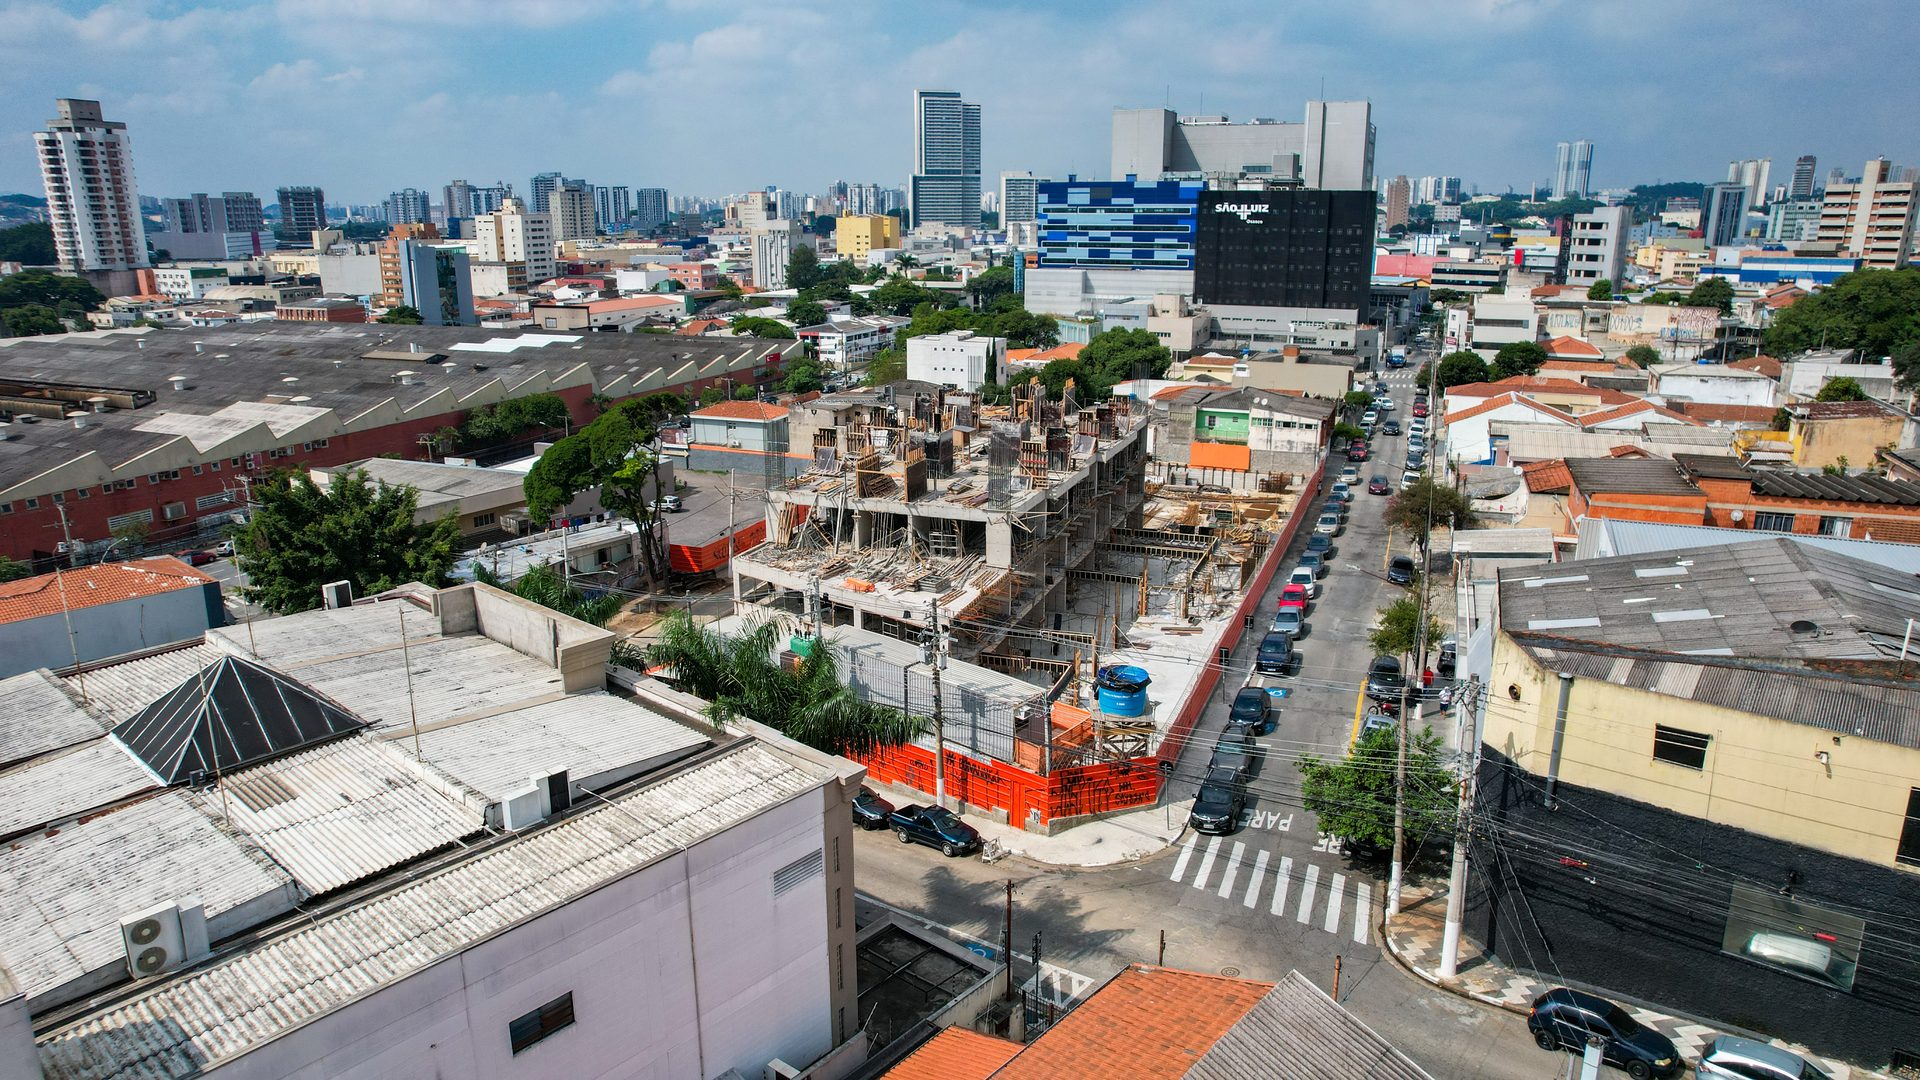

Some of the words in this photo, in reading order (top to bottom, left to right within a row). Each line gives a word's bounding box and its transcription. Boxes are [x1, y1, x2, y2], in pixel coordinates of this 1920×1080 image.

[1215, 202, 1237, 213] SÃO
[1238, 808, 1293, 831] PARE
[1312, 831, 1351, 856] RE
